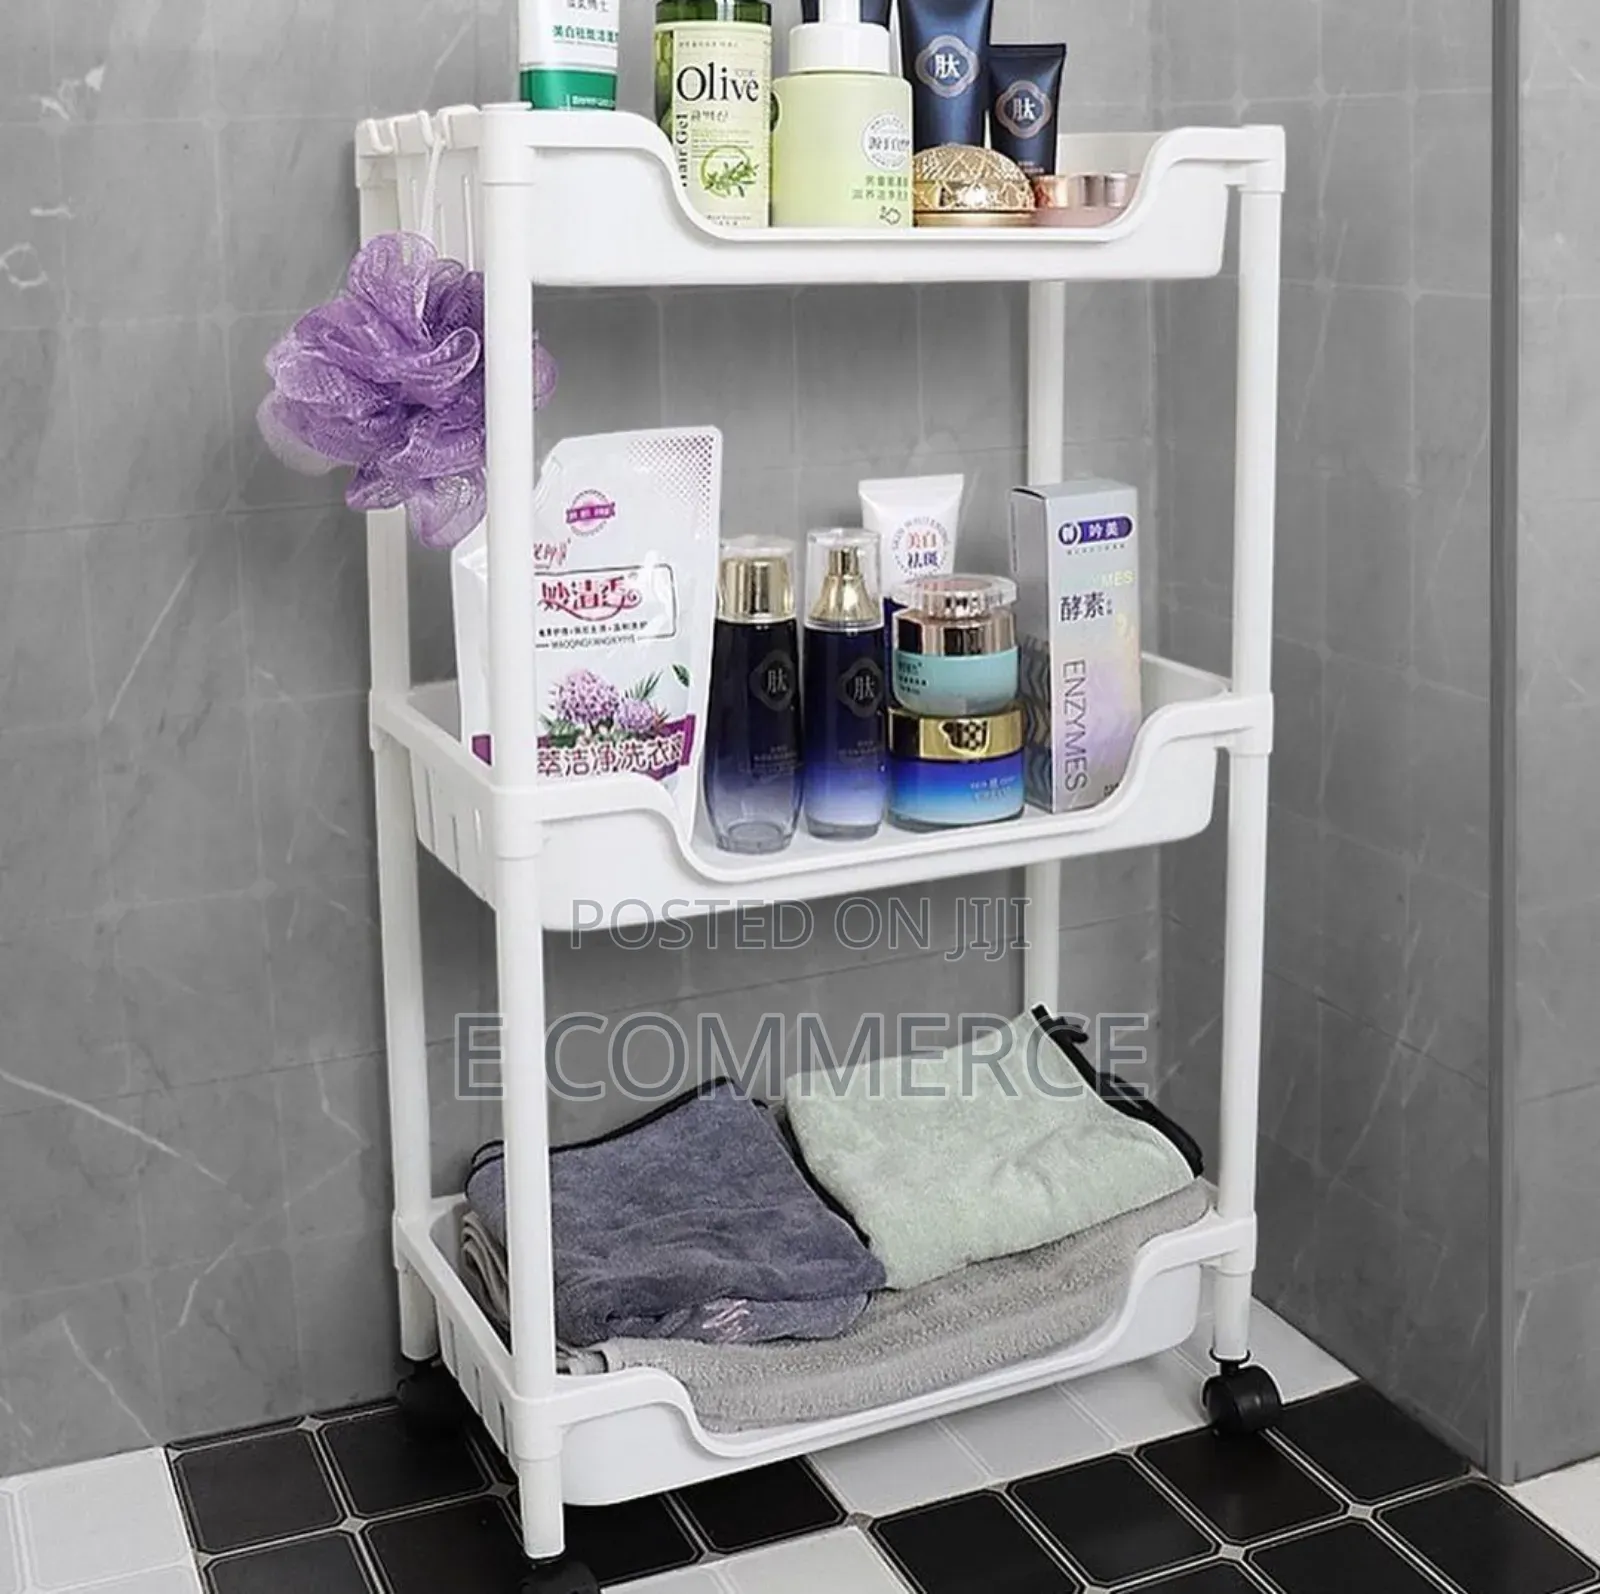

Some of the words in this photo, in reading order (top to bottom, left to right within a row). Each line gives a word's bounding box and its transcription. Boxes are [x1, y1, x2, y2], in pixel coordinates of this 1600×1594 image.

[677, 61, 759, 102] Olive
[675, 113, 688, 145] Gel
[1060, 591, 1105, 622] 酵素
[1063, 659, 1088, 792] ENZYMES
